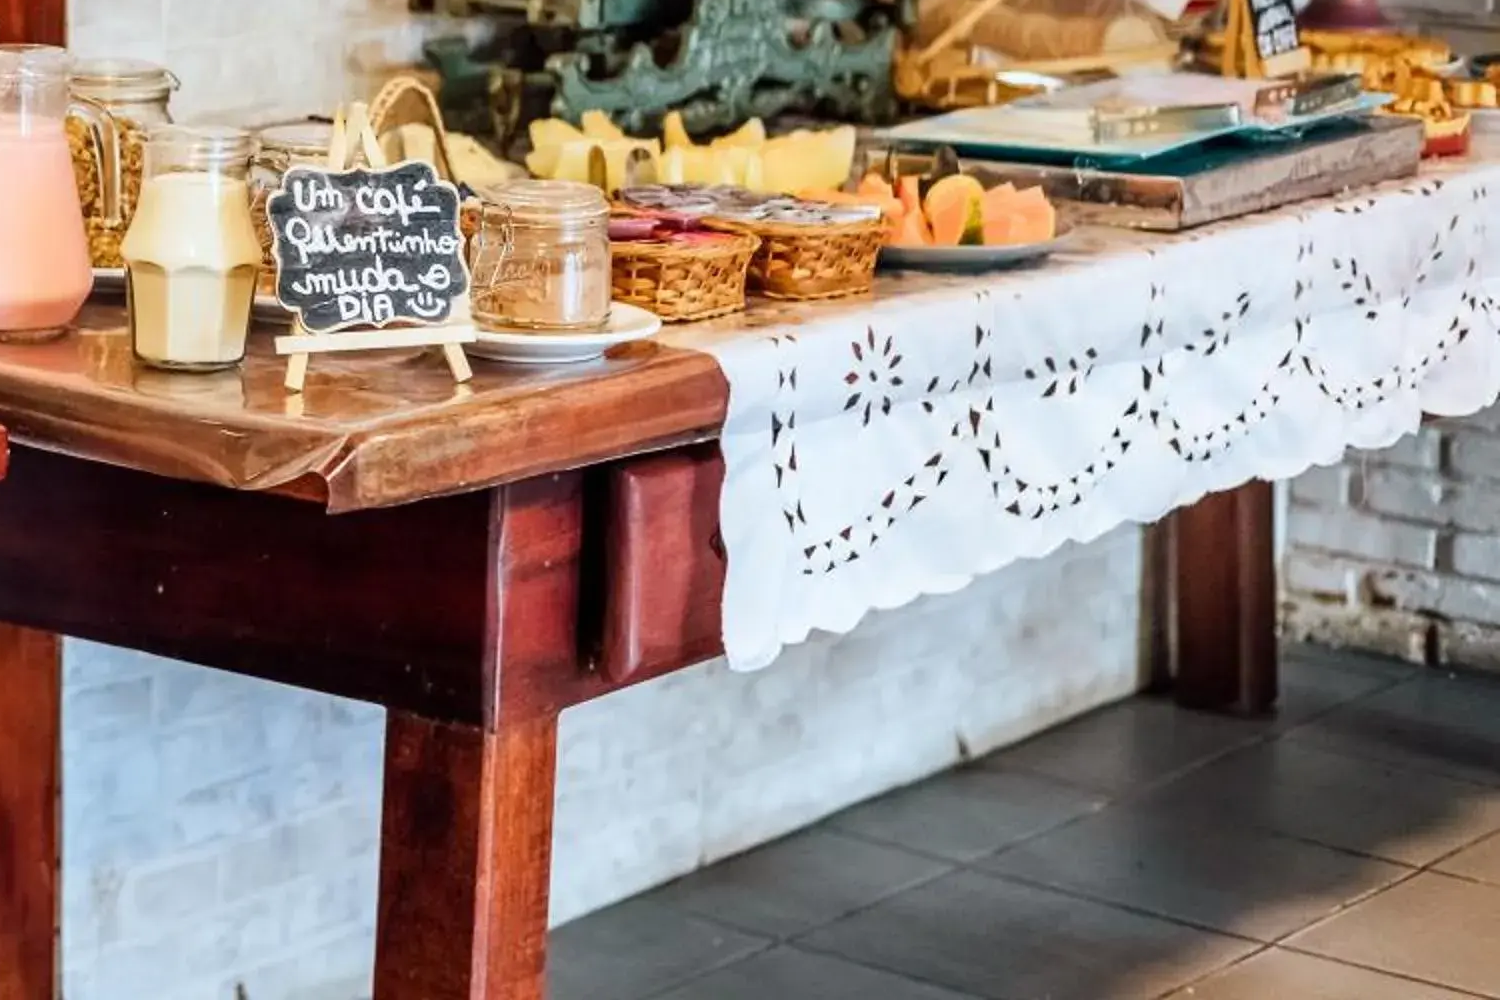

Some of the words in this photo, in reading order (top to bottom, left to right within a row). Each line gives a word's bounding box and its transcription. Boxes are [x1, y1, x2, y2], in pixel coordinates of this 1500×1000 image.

[293, 180, 343, 212] Um
[356, 179, 441, 226] café
[292, 254, 420, 295] muda
